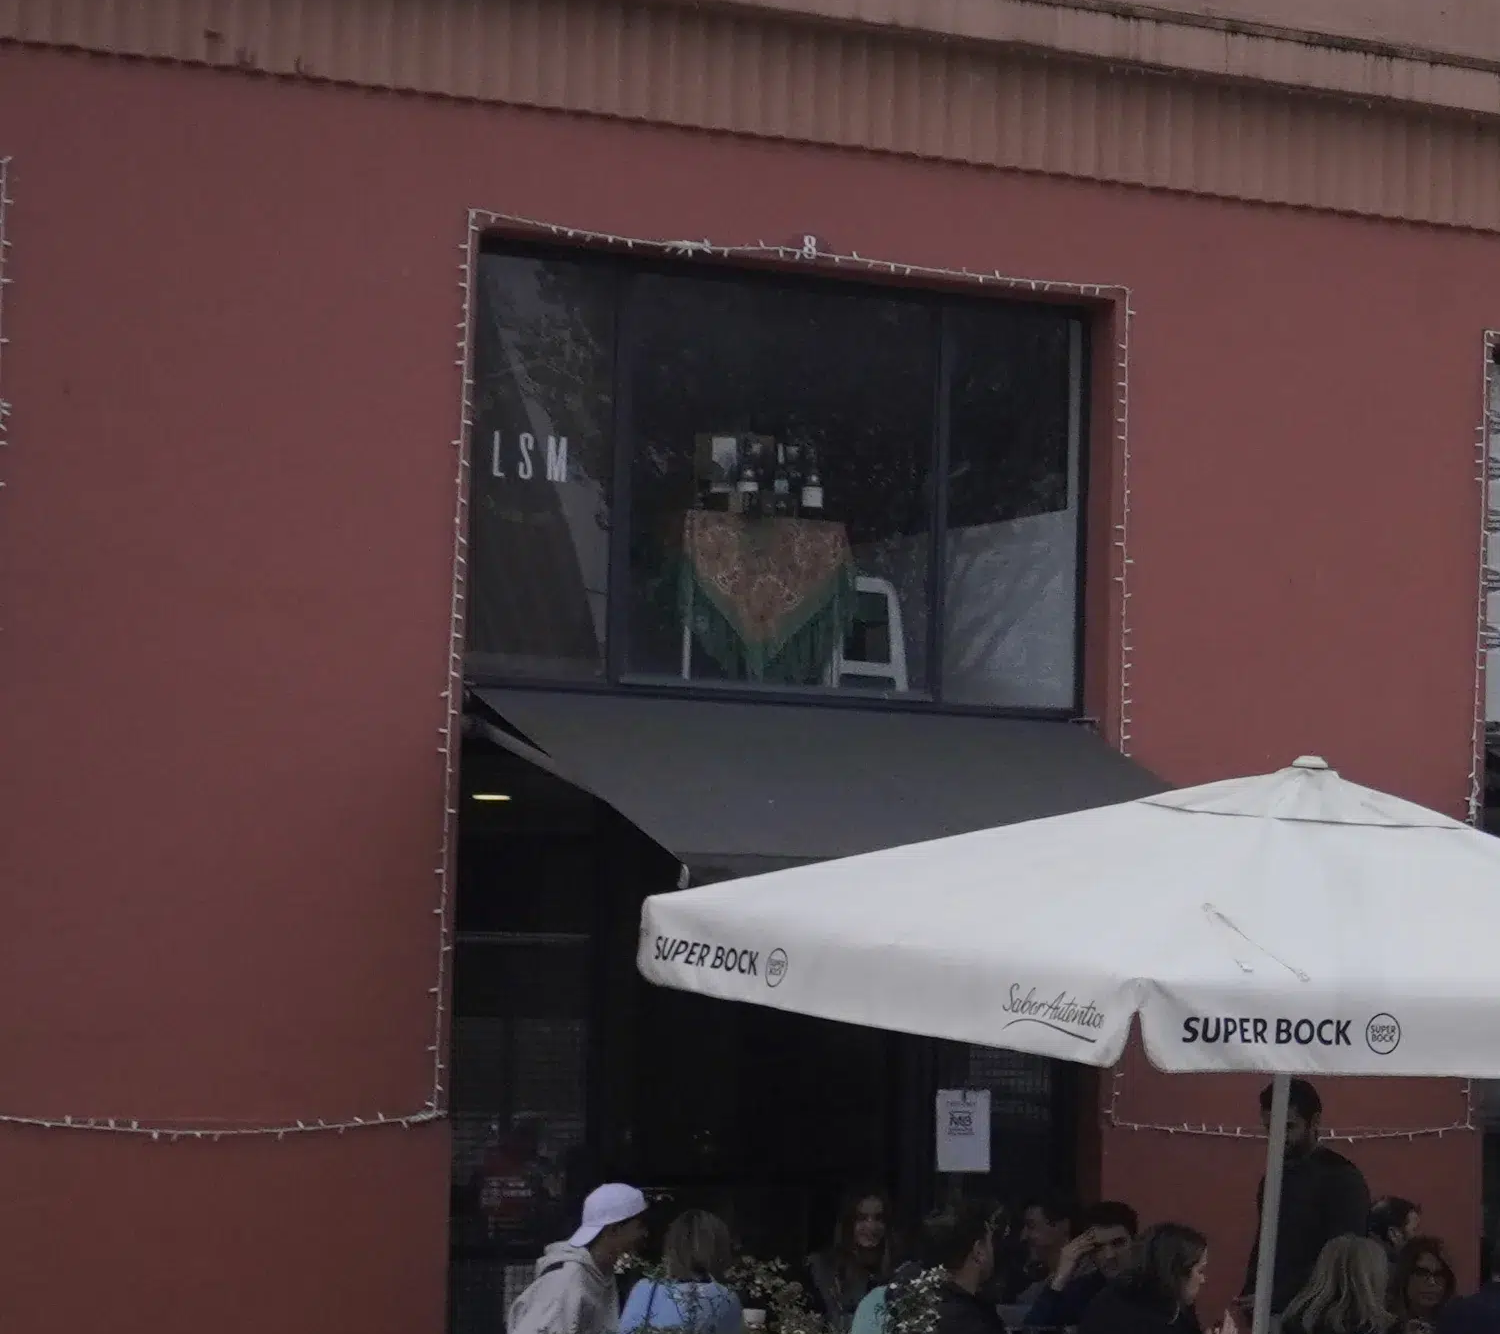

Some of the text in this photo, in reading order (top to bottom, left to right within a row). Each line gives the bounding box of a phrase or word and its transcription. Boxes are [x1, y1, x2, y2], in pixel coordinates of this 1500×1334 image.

[655, 935, 710, 968] SUPER
[711, 946, 759, 976] BOCK
[1181, 1017, 1352, 1046] SUPER BOCK
